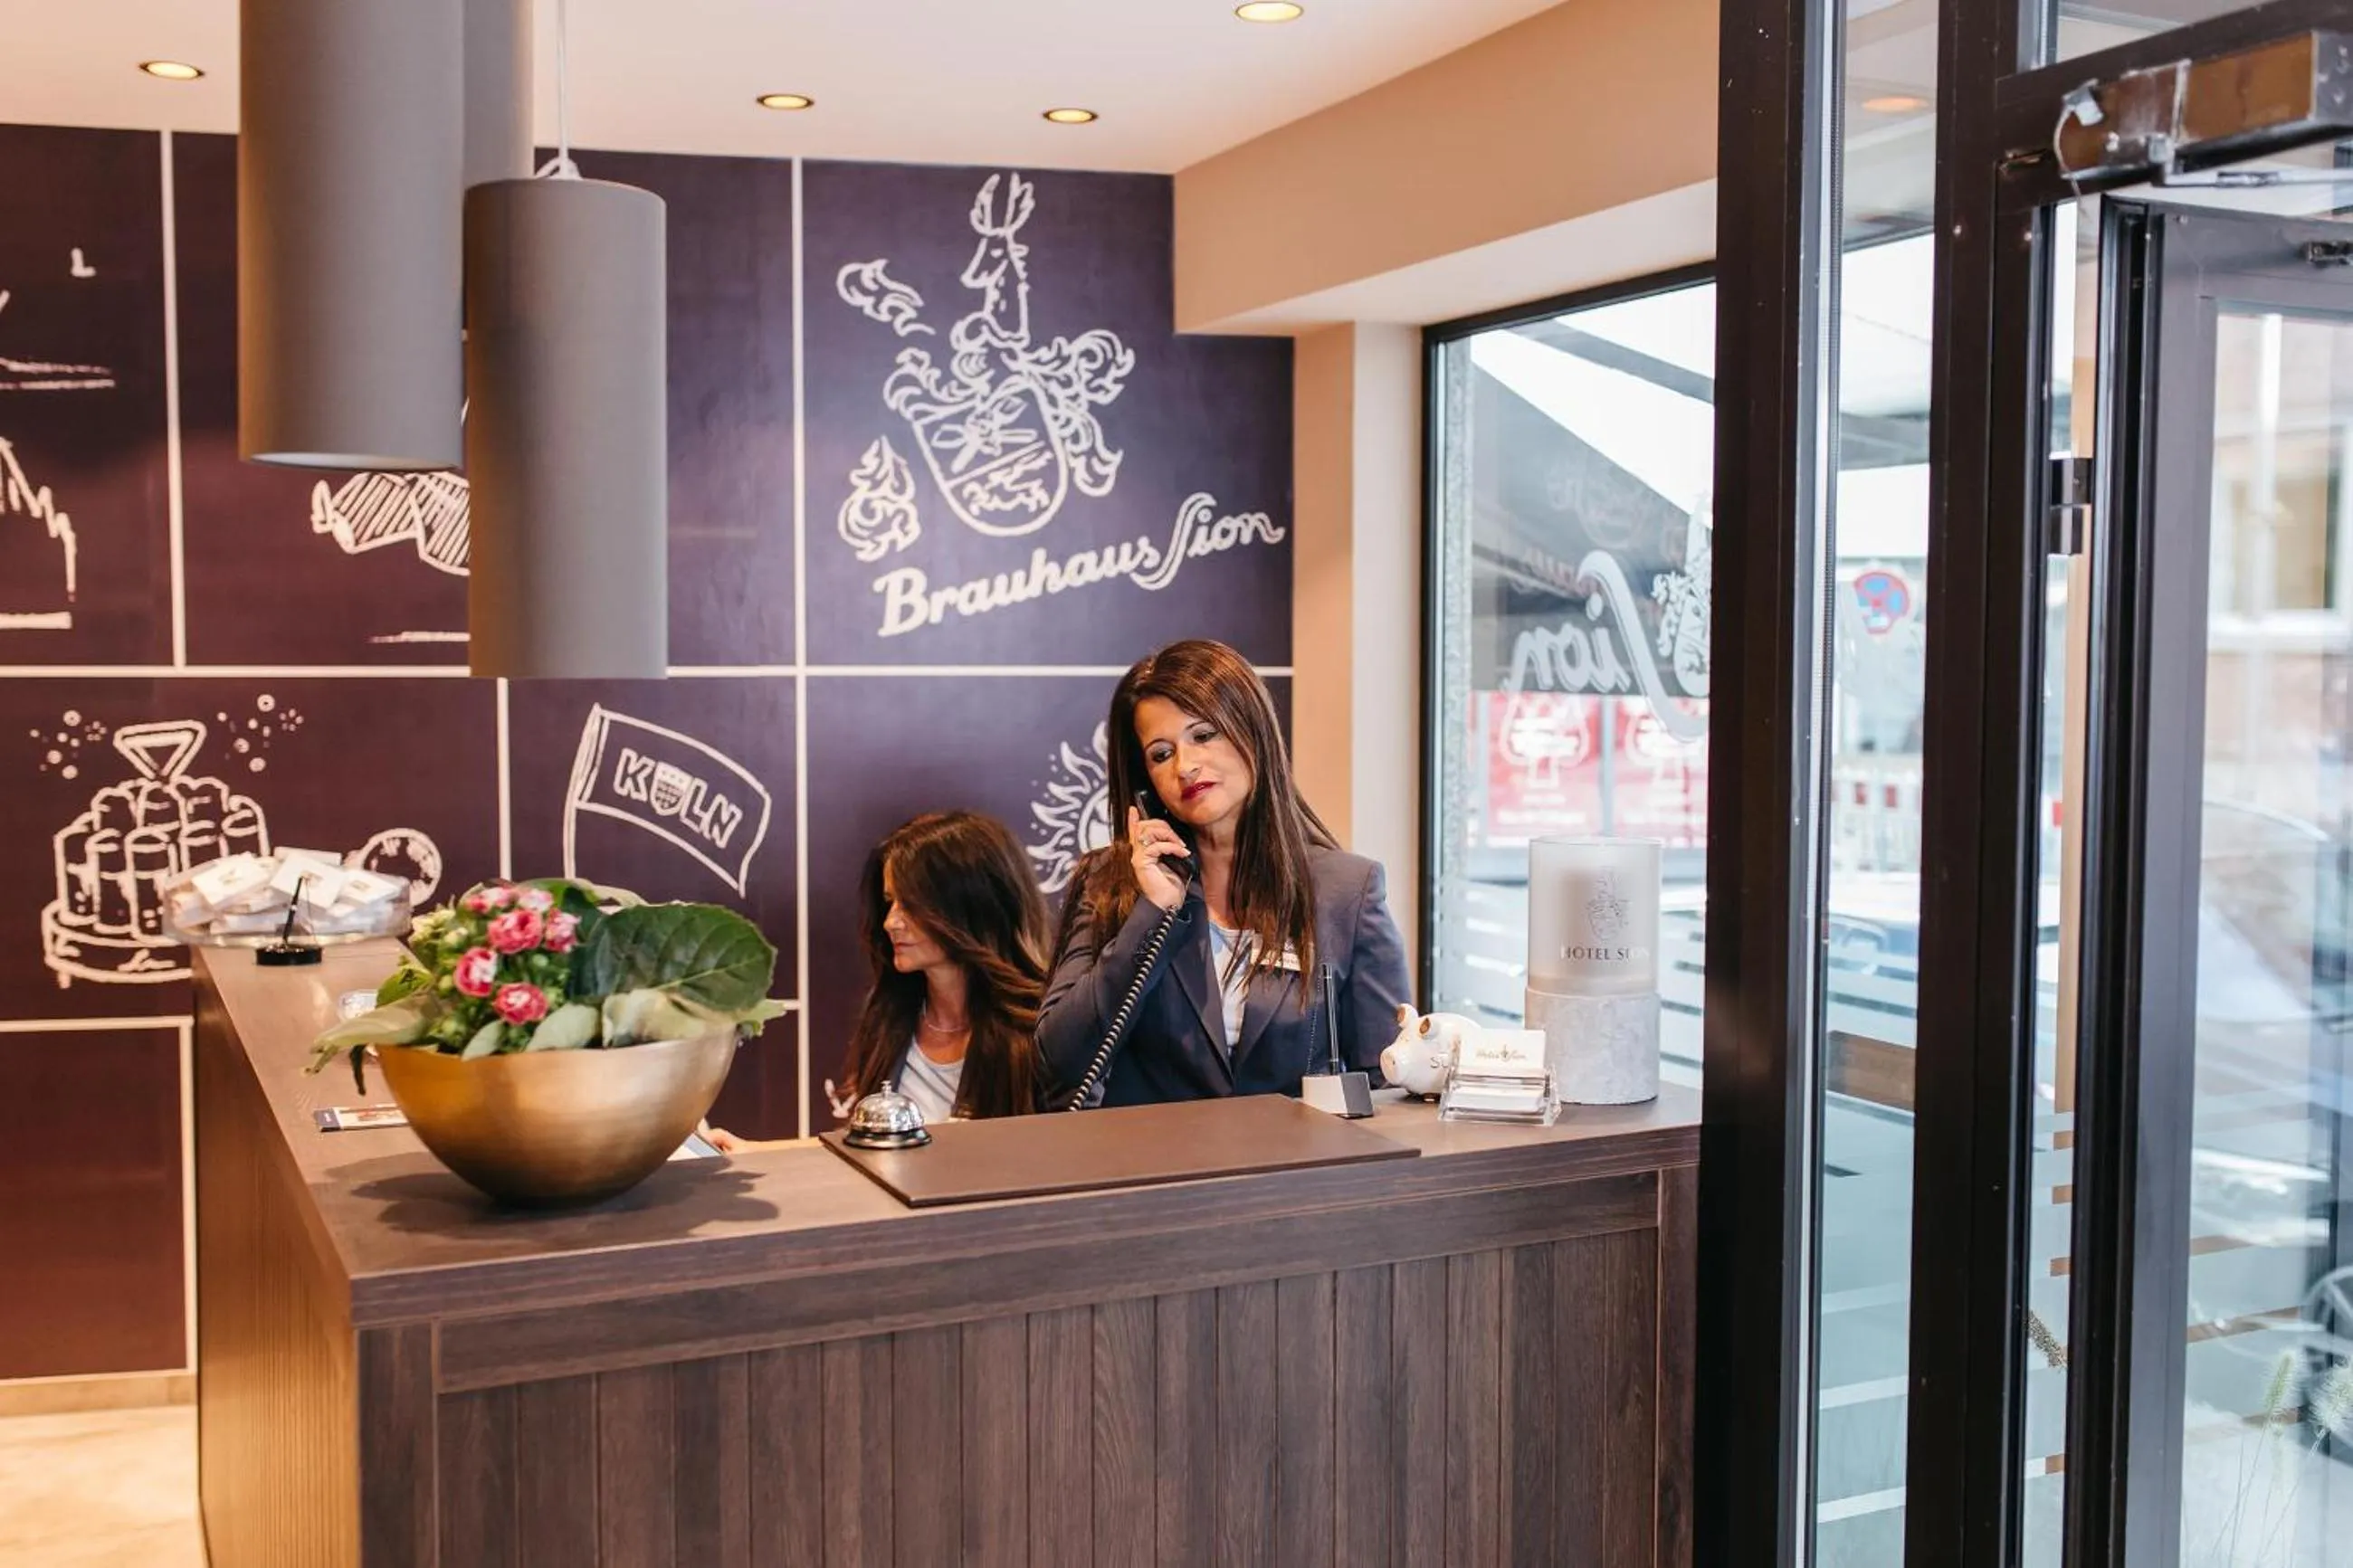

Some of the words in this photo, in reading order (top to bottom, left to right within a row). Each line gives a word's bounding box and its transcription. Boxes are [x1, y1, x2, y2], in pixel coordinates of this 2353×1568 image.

[872, 536, 1160, 637] Brauhaus
[1129, 491, 1285, 590] Sion
[1559, 947, 1610, 960] HOTEL
